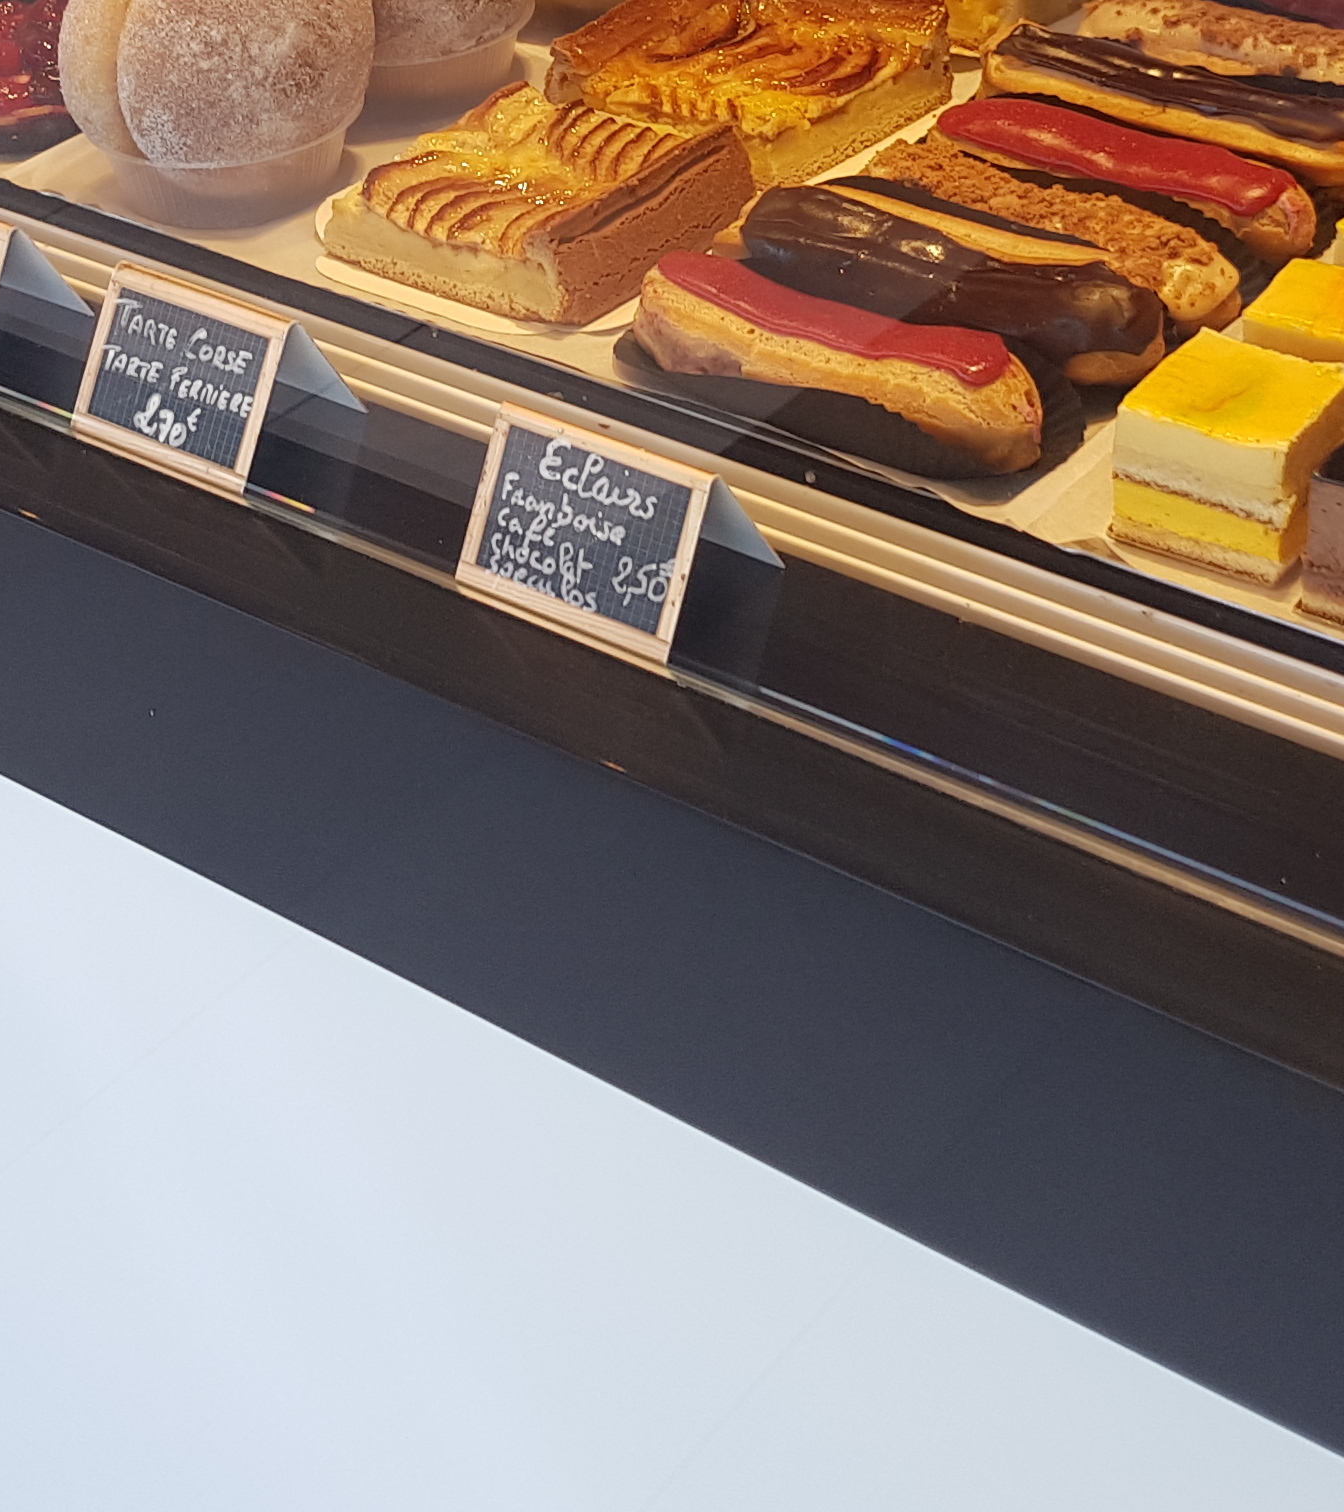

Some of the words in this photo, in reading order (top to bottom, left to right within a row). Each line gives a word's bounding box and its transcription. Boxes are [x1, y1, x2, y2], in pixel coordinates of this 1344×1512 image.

[103, 344, 164, 383] TARTE
[183, 327, 253, 375] CORSE
[539, 439, 658, 520] Eclairs
